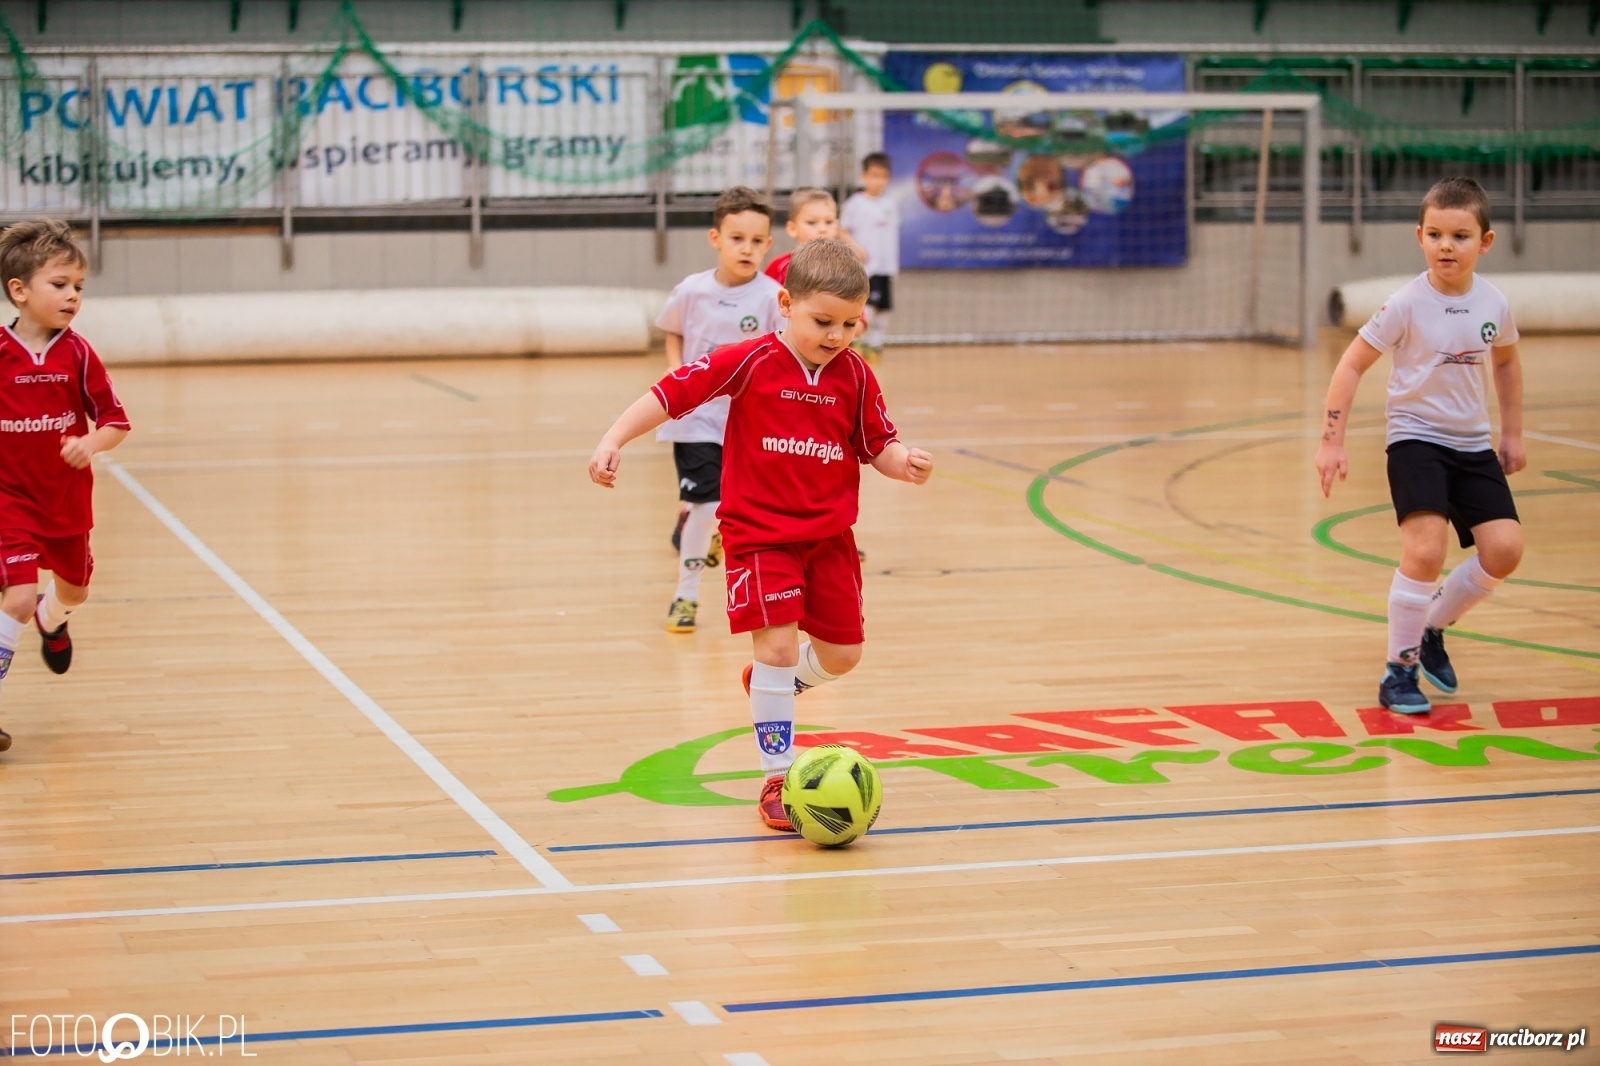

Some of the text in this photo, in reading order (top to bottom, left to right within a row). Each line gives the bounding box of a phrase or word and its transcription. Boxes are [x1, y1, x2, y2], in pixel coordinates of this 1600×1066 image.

[22, 63, 621, 132] POWIAT RACIBORSKI
[502, 133, 626, 170] gramy
[14, 374, 69, 384] GIVOVA
[780, 389, 837, 406] GIVOVA
[762, 437, 844, 465] motofrajda
[764, 588, 802, 602] GIVOVA
